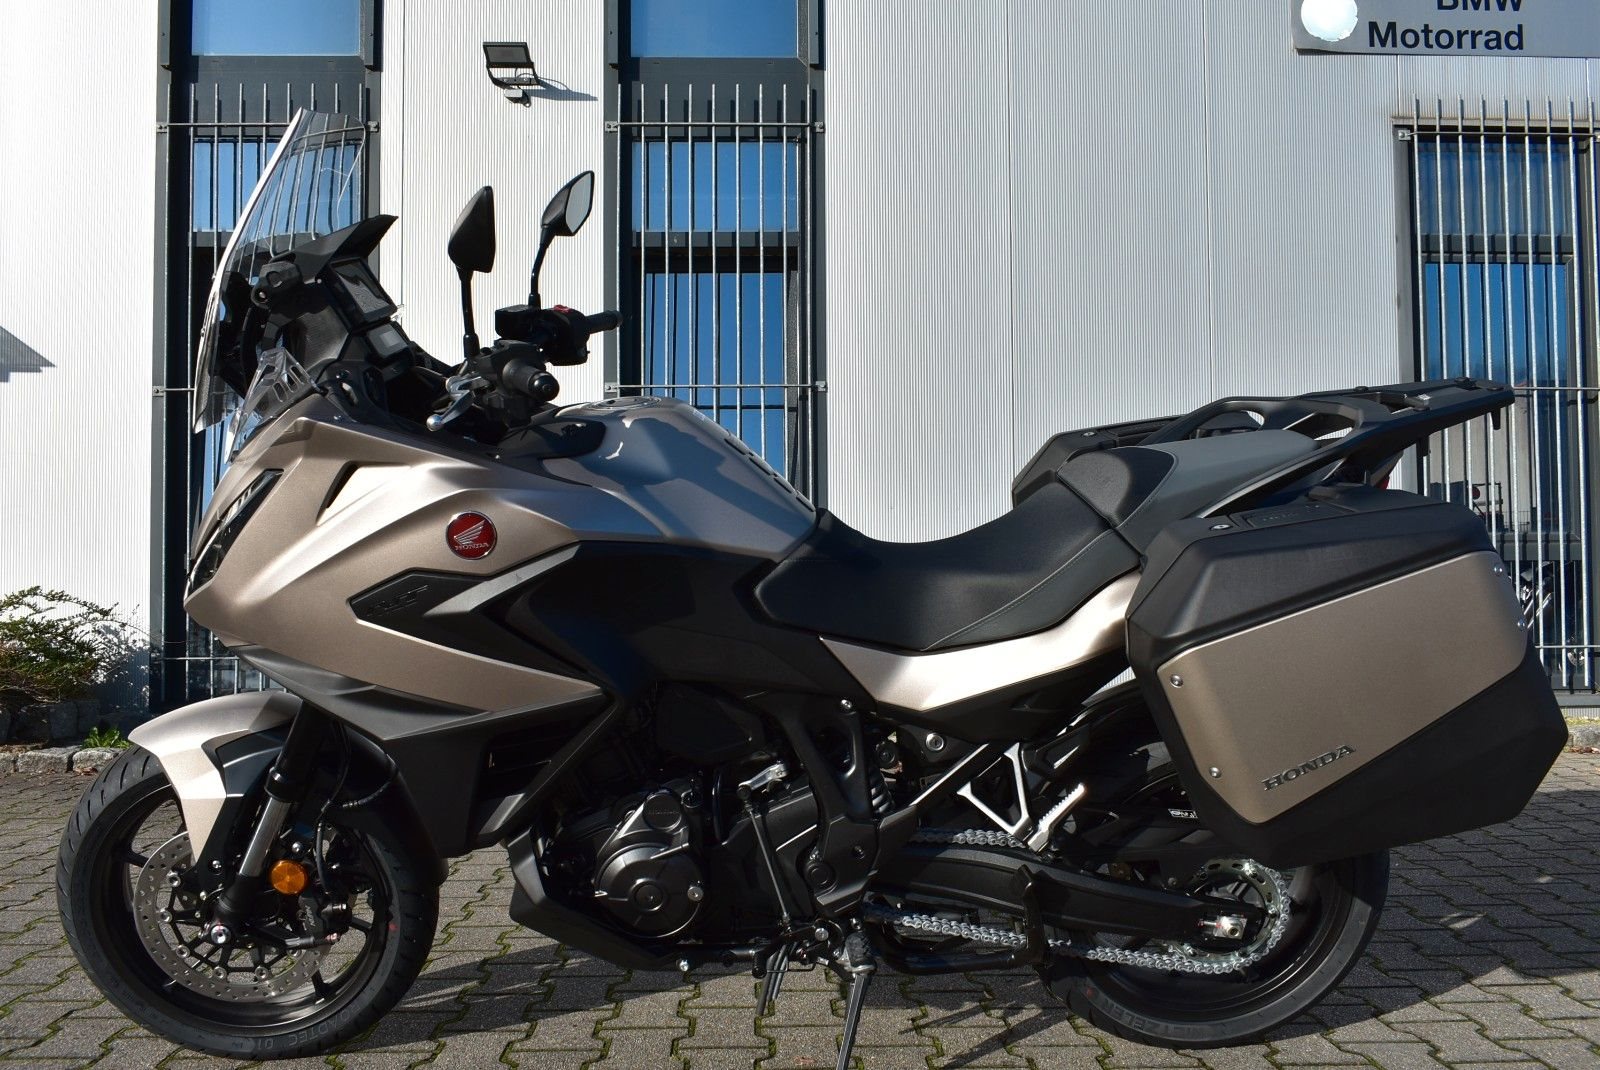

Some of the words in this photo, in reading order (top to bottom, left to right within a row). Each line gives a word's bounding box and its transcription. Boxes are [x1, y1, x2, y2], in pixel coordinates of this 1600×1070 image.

[1368, 21, 1524, 51] Motorrad
[454, 542, 489, 551] HONDA
[1260, 744, 1356, 792] HONDA
